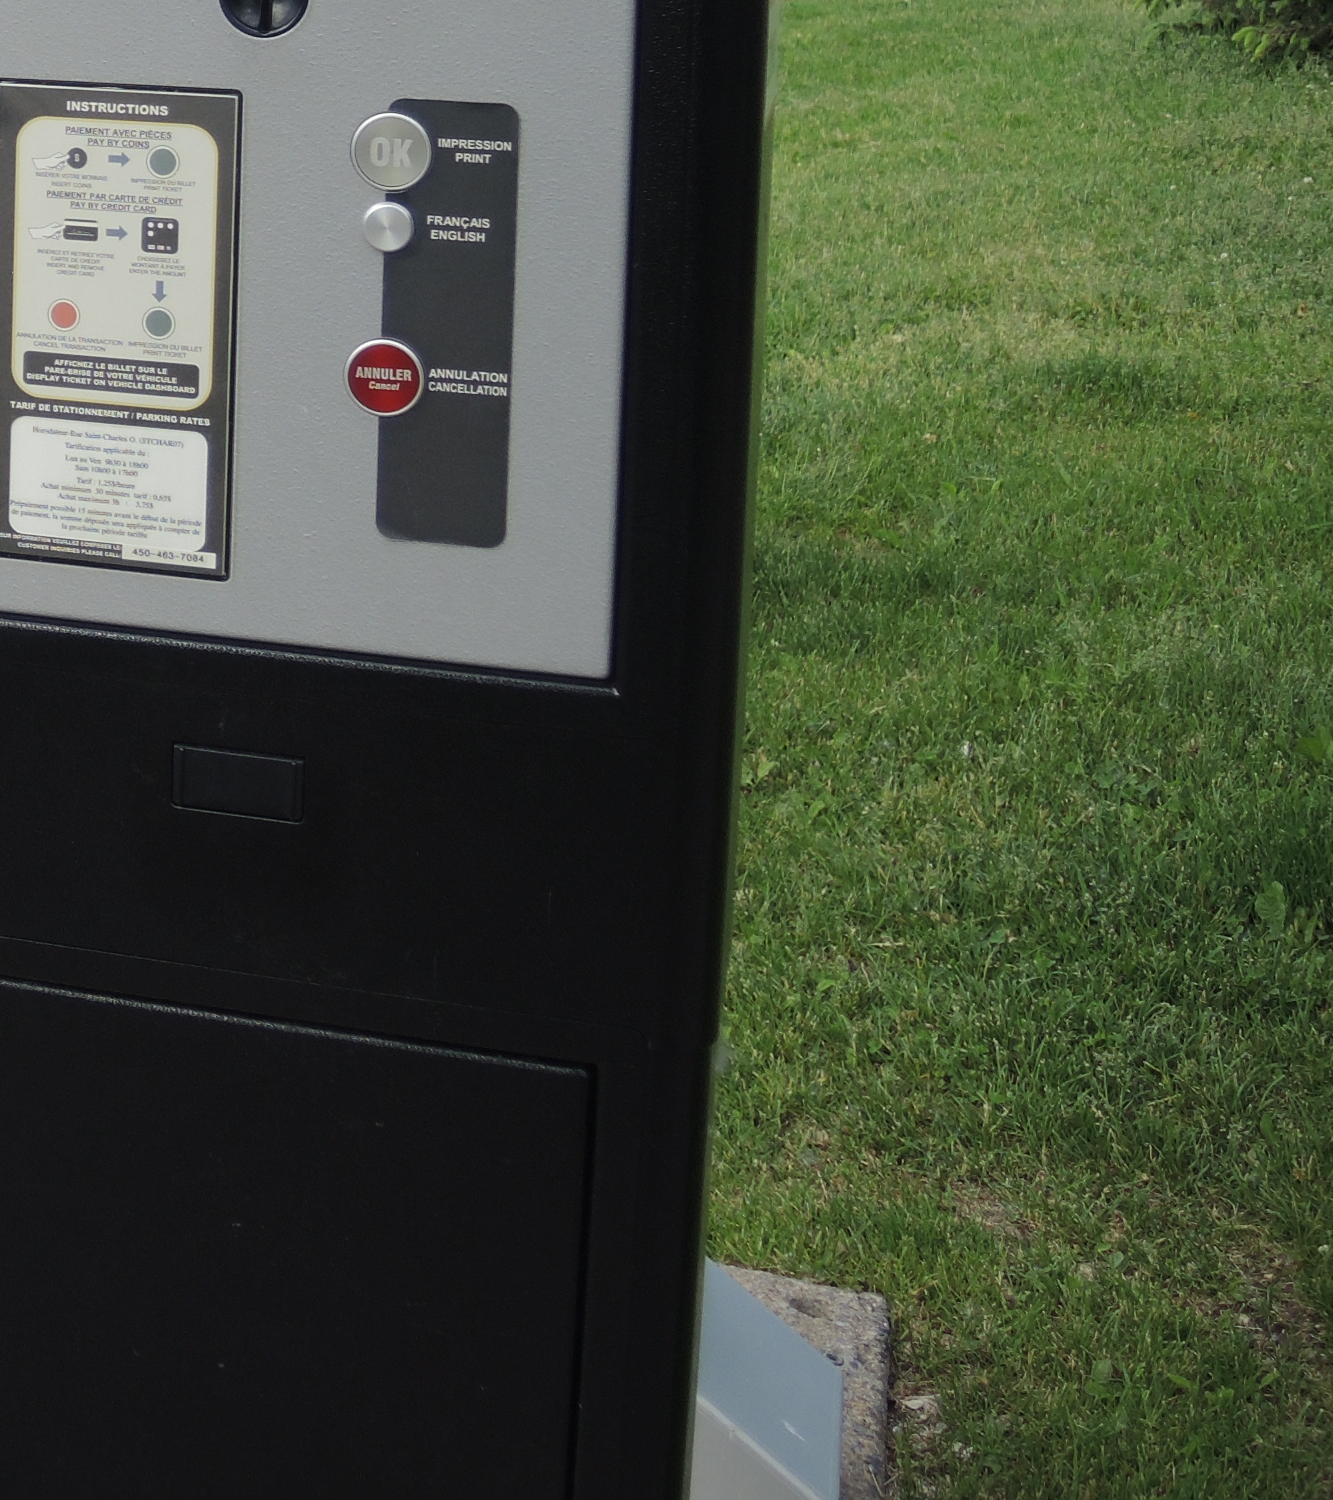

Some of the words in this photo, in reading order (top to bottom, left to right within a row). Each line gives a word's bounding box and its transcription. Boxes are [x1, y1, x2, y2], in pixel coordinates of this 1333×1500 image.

[65, 100, 170, 116] INSTRUCTIONS
[65, 126, 111, 137] PAIEMENT
[112, 128, 137, 138] AVEC
[87, 137, 106, 146] PAY
[107, 139, 119, 147] BY
[121, 140, 150, 149] COINS
[437, 138, 512, 152] IMPRESSION
[369, 136, 414, 168] OK
[455, 152, 492, 164] PRINT
[46, 190, 87, 200] PAIEMENT
[89, 192, 107, 201] PAR
[108, 194, 137, 203] CARTE
[138, 196, 149, 204] DE
[151, 196, 183, 206] CRÉDIT
[70, 201, 86, 210] PAY
[88, 202, 99, 211] BY
[101, 203, 131, 213] CREDIT
[133, 205, 157, 214] CARD
[426, 215, 491, 230] FRANÇAIS
[430, 230, 486, 243] ENGLISH
[17, 331, 57, 341] ANNULATION
[77, 336, 124, 346] TRANSACTION
[34, 340, 60, 349] CANCEL
[61, 342, 106, 352] TRANSACTION
[54, 359, 94, 369] AFFICHEZ
[96, 361, 106, 370] LE
[108, 362, 137, 372] BILLET
[138, 365, 156, 374] SUR
[157, 367, 168, 375] LE
[93, 369, 104, 378] DE
[107, 371, 134, 380] VOTRE
[355, 366, 412, 382] ANNULER
[26, 373, 60, 383] DISPLAY
[61, 376, 92, 385] TICKET
[94, 378, 106, 386] ON
[108, 379, 143, 390] VEHICLE
[145, 382, 196, 394] DASHBOARD
[428, 368, 508, 384] ANNULATION
[368, 381, 400, 391] Cancel
[428, 381, 508, 397] CANCELLATION
[10, 400, 36, 410] TARIF
[38, 403, 51, 412] DE
[53, 405, 131, 420] STATIONNEMENT
[136, 412, 178, 424] PARKING
[180, 416, 211, 426] RATES
[132, 548, 204, 563] 450-463-7084
